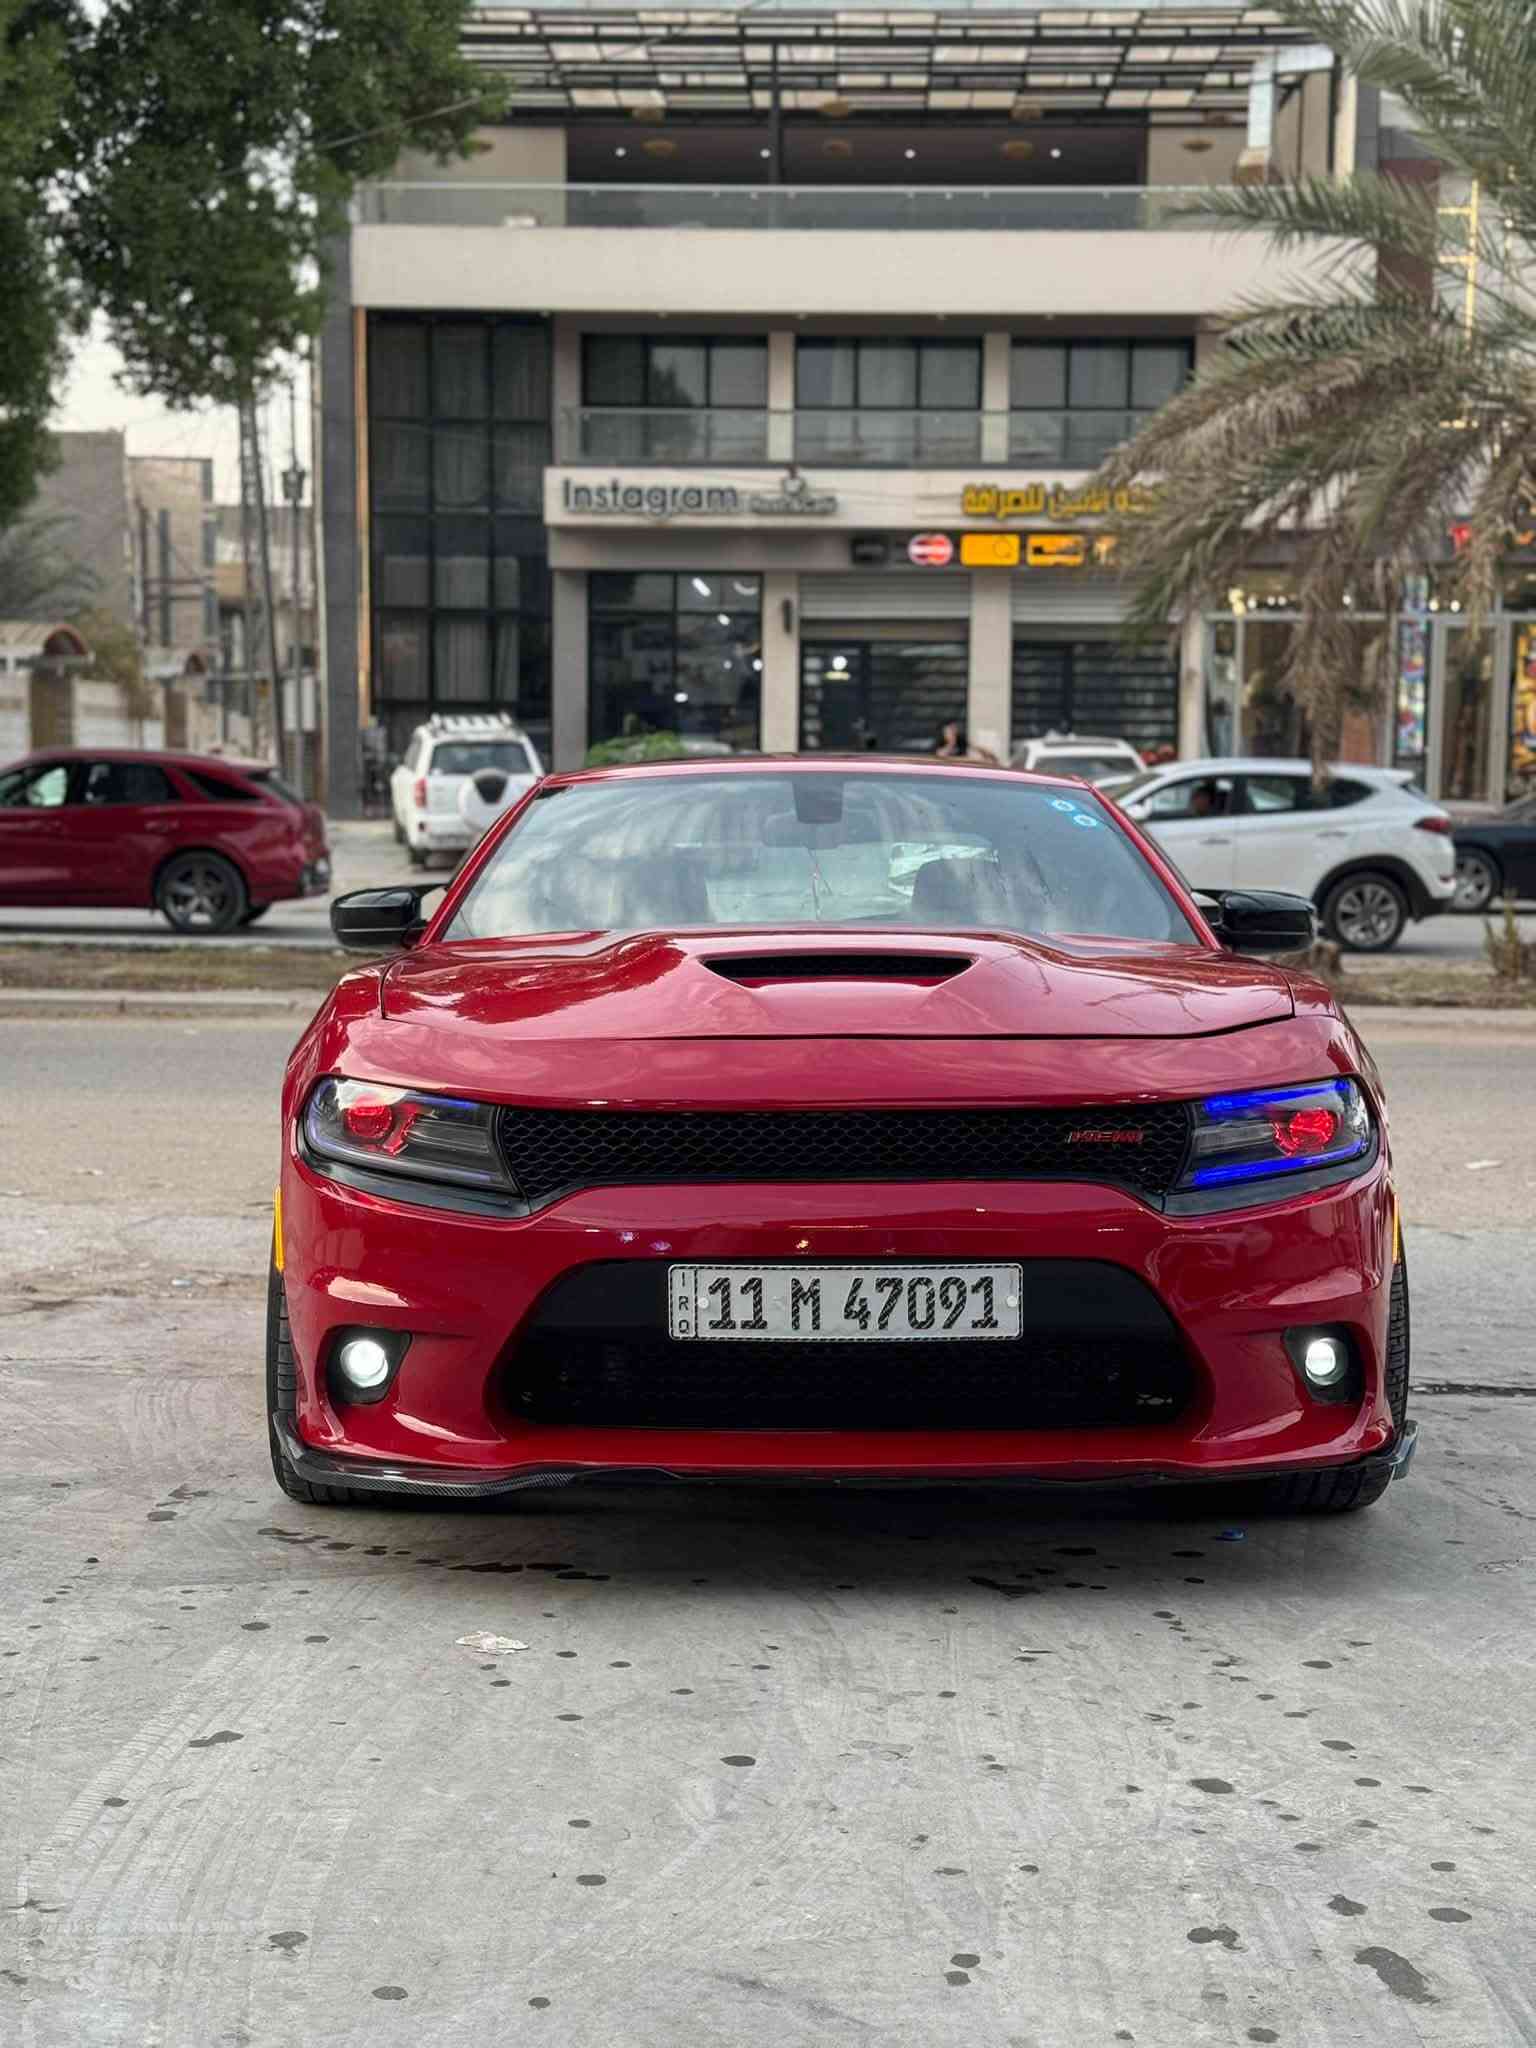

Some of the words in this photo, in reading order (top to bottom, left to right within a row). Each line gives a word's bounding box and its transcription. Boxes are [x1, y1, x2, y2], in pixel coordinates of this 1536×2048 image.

[563, 479, 738, 517] Instagram
[678, 1271, 690, 1335] IRQ
[708, 1277, 768, 1330] 11
[791, 1277, 821, 1330] M
[843, 1276, 999, 1329] 47091
